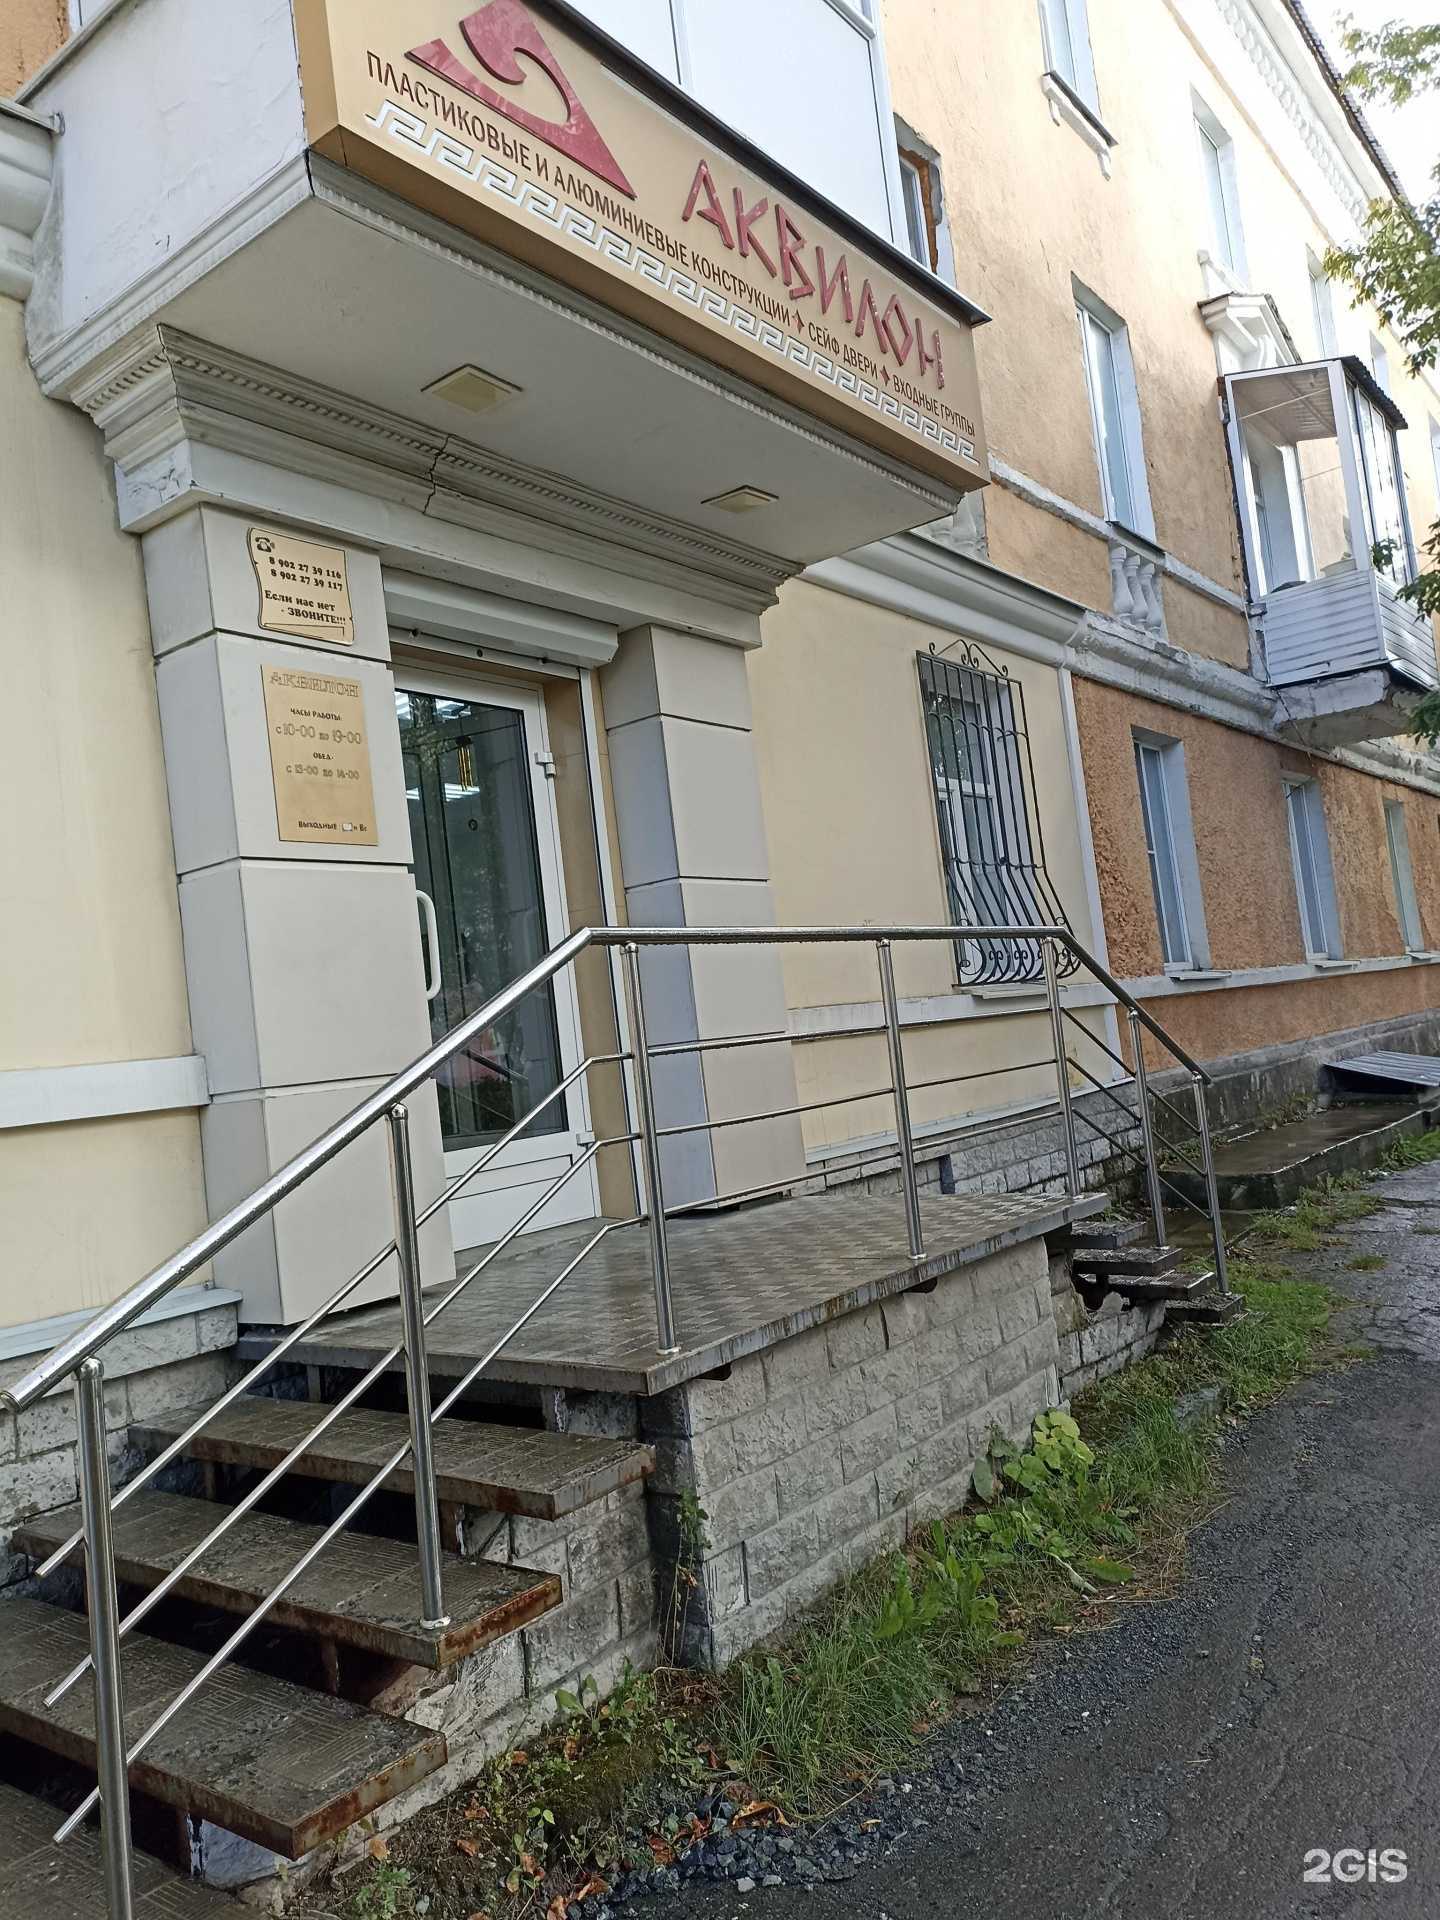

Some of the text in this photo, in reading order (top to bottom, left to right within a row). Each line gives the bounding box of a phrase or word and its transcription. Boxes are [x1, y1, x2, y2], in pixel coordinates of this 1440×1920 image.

[366, 50, 976, 437] ПЛАСТИКОВЫЕ И АЛЮМИНИЕВЫЕ КОНСТРУКЦИИ СЕЙФ ДВЕРИ ВХОДНЫЕ ГРУППЫ
[681, 159, 945, 390] АКВИЛОН
[268, 556, 275, 565] 8
[278, 558, 296, 570] 902
[298, 563, 309, 573] 27
[312, 566, 323, 576] 39
[270, 568, 343, 592] 8 902 27 39 117
[264, 589, 336, 612] Если нас нет
[290, 707, 311, 717] ЧАСЫ
